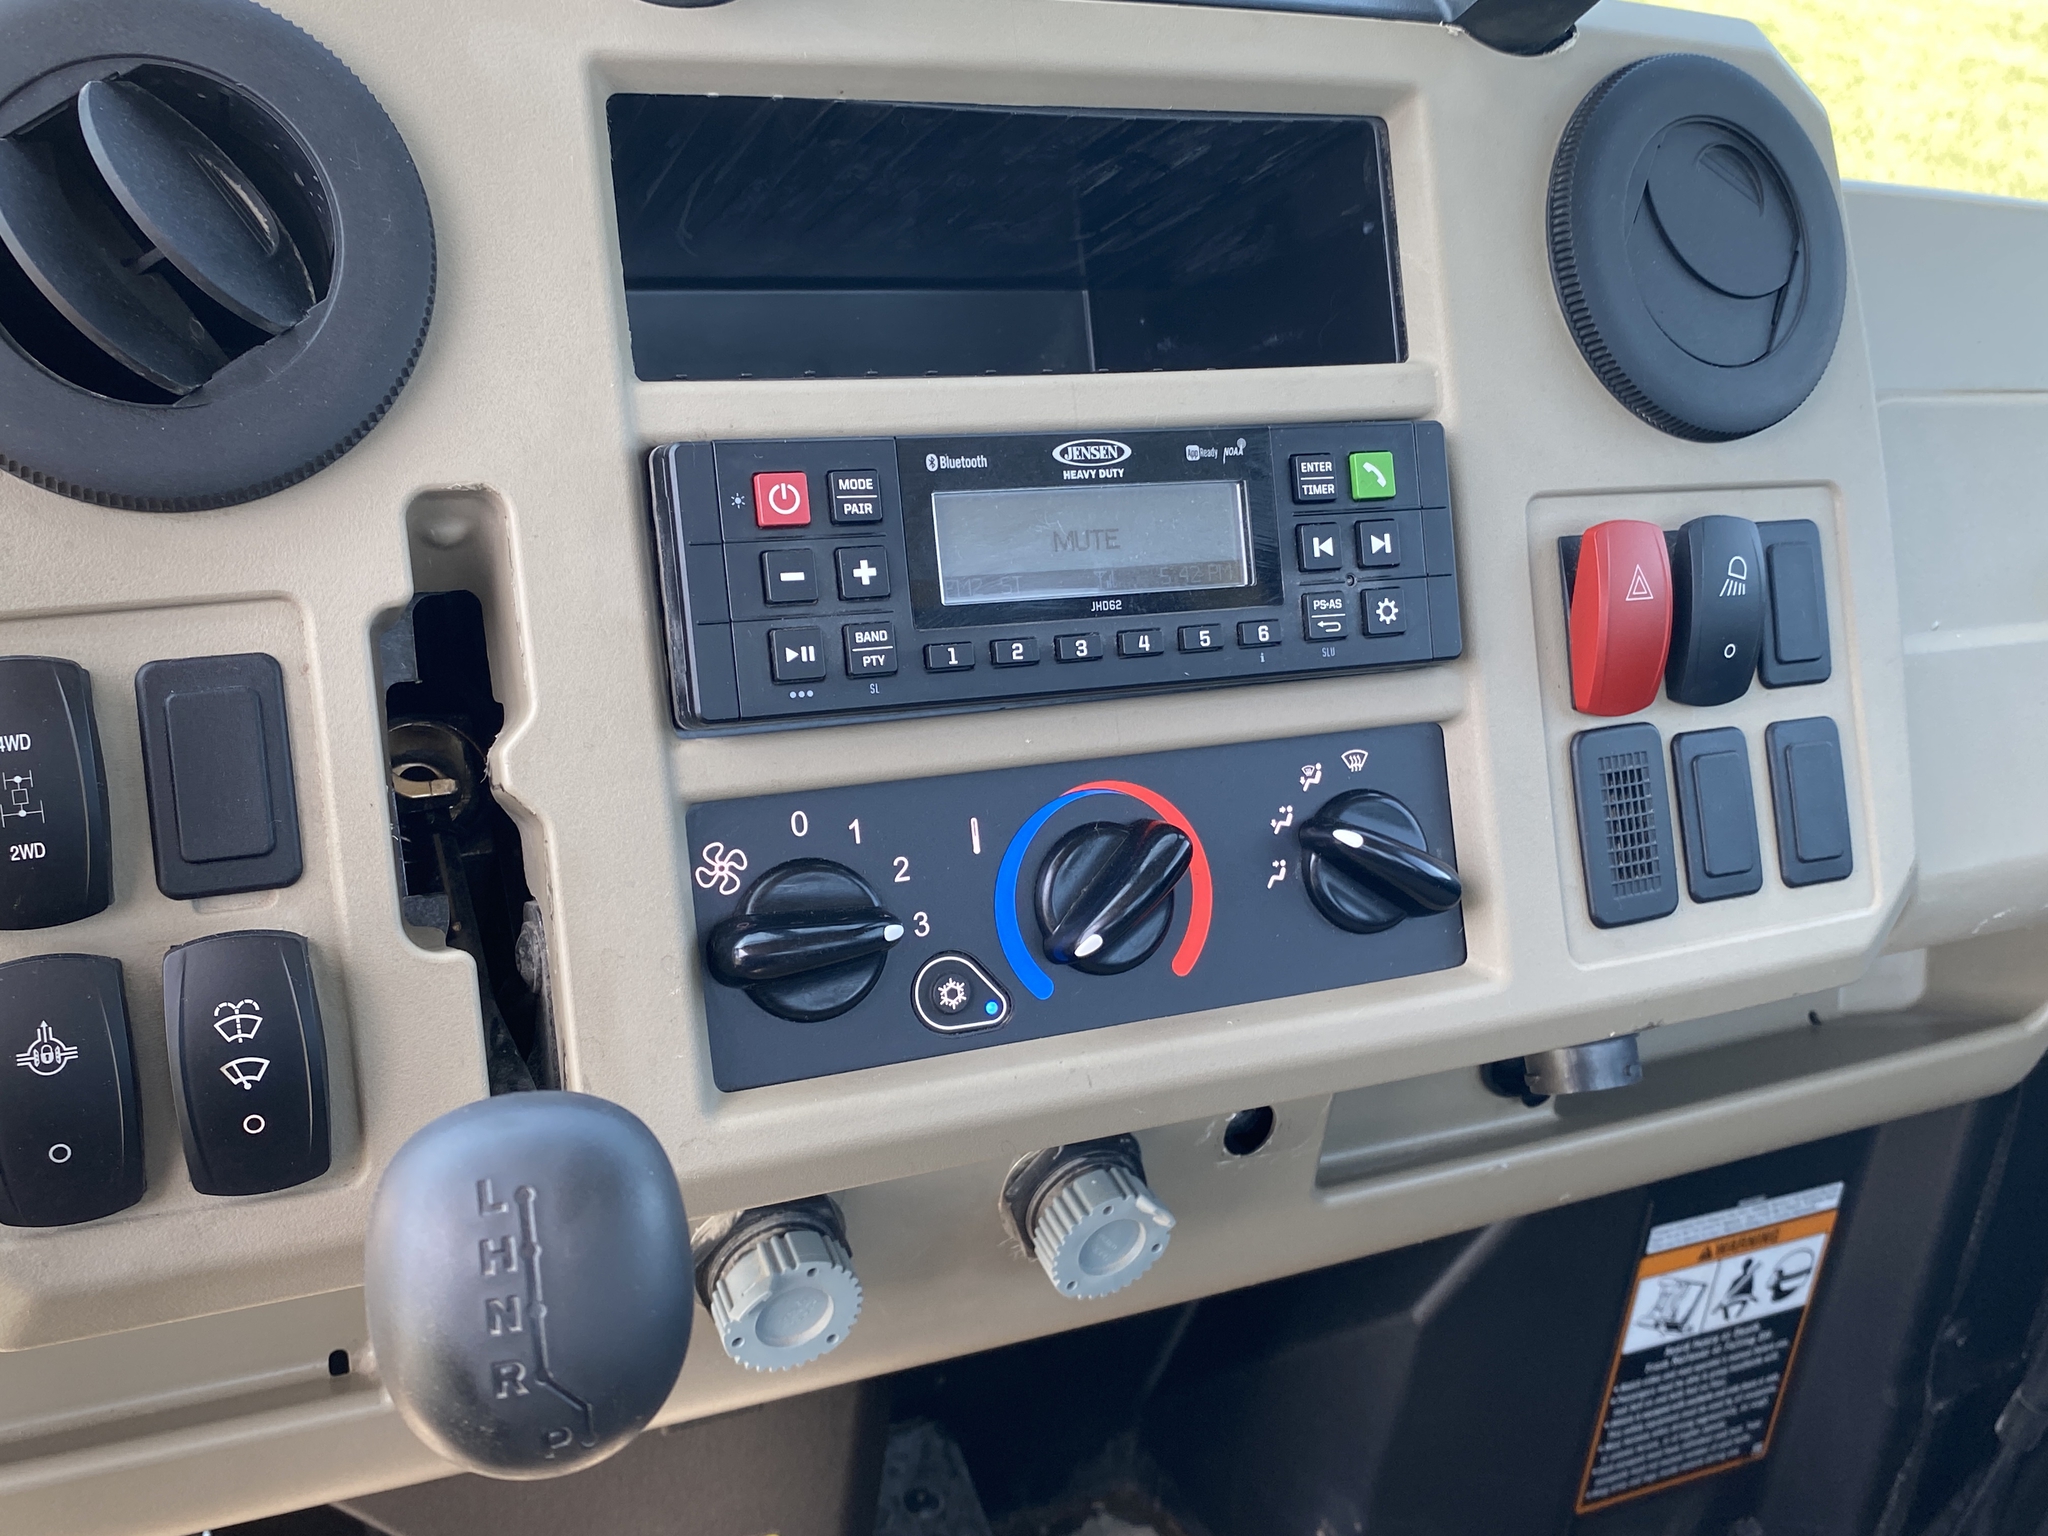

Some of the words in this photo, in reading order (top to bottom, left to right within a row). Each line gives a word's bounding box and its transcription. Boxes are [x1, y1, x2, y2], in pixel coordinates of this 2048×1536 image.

[1064, 445, 1119, 461] JENSEN
[939, 454, 988, 470] Bluetooth
[1300, 461, 1333, 474] ENTER
[1063, 470, 1096, 480] HEAVY
[1098, 468, 1124, 479] DUTY
[838, 478, 874, 491] MODE
[1302, 483, 1335, 496] TIMER
[843, 503, 873, 516] PAIR
[1052, 528, 1121, 552] MUTE
[1090, 600, 1123, 612] JHD62
[854, 630, 888, 643] BAND
[1199, 630, 1211, 647] 5
[1257, 625, 1270, 642] 6
[1011, 643, 1024, 660] 2
[1075, 639, 1088, 657] 3
[1138, 634, 1151, 652] 4
[862, 655, 885, 667] PTY
[947, 647, 959, 665] 1
[869, 682, 880, 694] SL
[790, 810, 808, 837] 0
[848, 818, 861, 844] 1
[9, 842, 46, 861] 2WD
[893, 856, 911, 882] 2
[913, 911, 930, 937] 3
[476, 1178, 509, 1216] L
[479, 1235, 519, 1275] H
[485, 1295, 523, 1336] N
[491, 1360, 529, 1399] R
